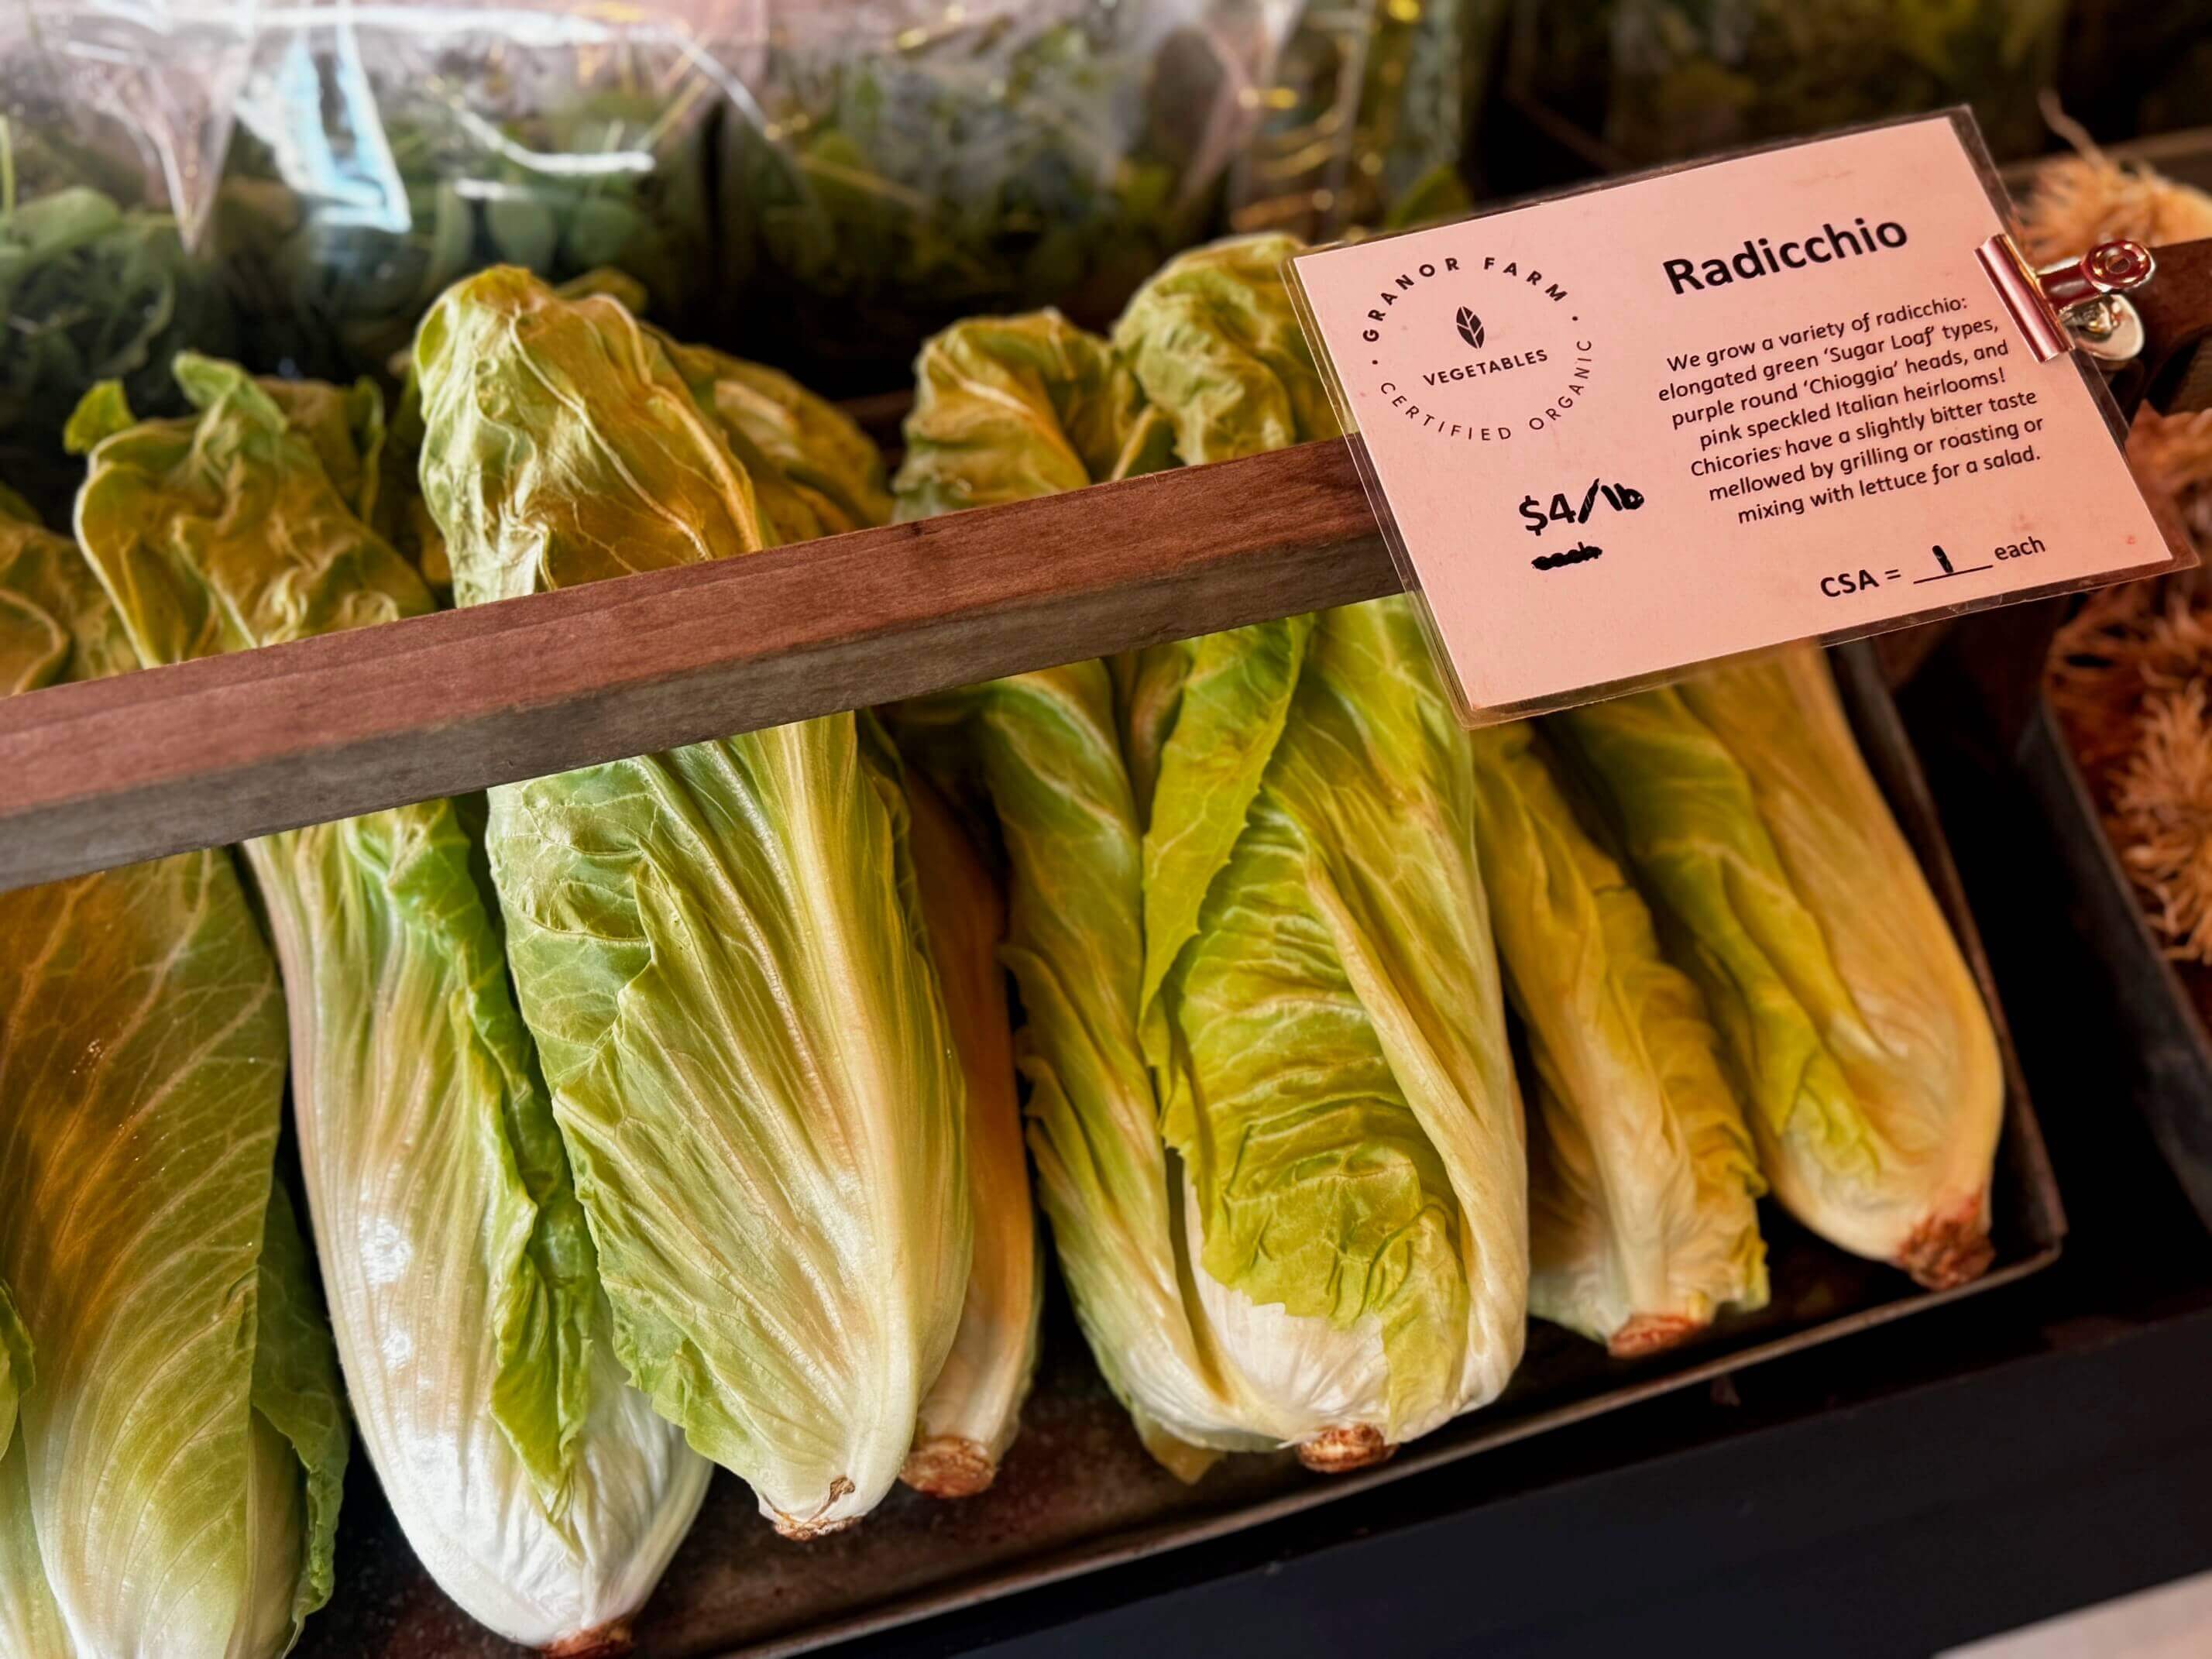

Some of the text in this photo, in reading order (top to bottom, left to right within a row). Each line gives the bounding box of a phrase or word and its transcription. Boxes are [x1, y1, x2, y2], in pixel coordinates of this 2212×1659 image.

[1663, 218, 1908, 294] Radicchio
[1362, 256, 1568, 342] GRANOR FARM
[1667, 297, 1967, 372] We grow a variety of radicchio:
[1380, 340, 1592, 441] CERTIFIED ORGANIC
[1422, 349, 1548, 386] VEGETABLES
[1658, 366, 1757, 401] elongated
[1764, 355, 1819, 380] green
[1942, 319, 1998, 341] types,
[1672, 400, 1734, 430] purple
[1741, 383, 1798, 410] round
[1905, 350, 1968, 374] heads,
[1973, 339, 2008, 360] and
[1692, 392, 2038, 476] Chicories have a slightly bitter taste
[1700, 366, 2005, 451] pink speckled Italian heirlooms!
[1709, 417, 2043, 501] mellowed by grilling or roasting or
[1738, 445, 2041, 524] mixing with lettuce for a salad.
[1820, 569, 1880, 597] CSA
[1884, 569, 1901, 579] =
[1994, 536, 2046, 560] each
